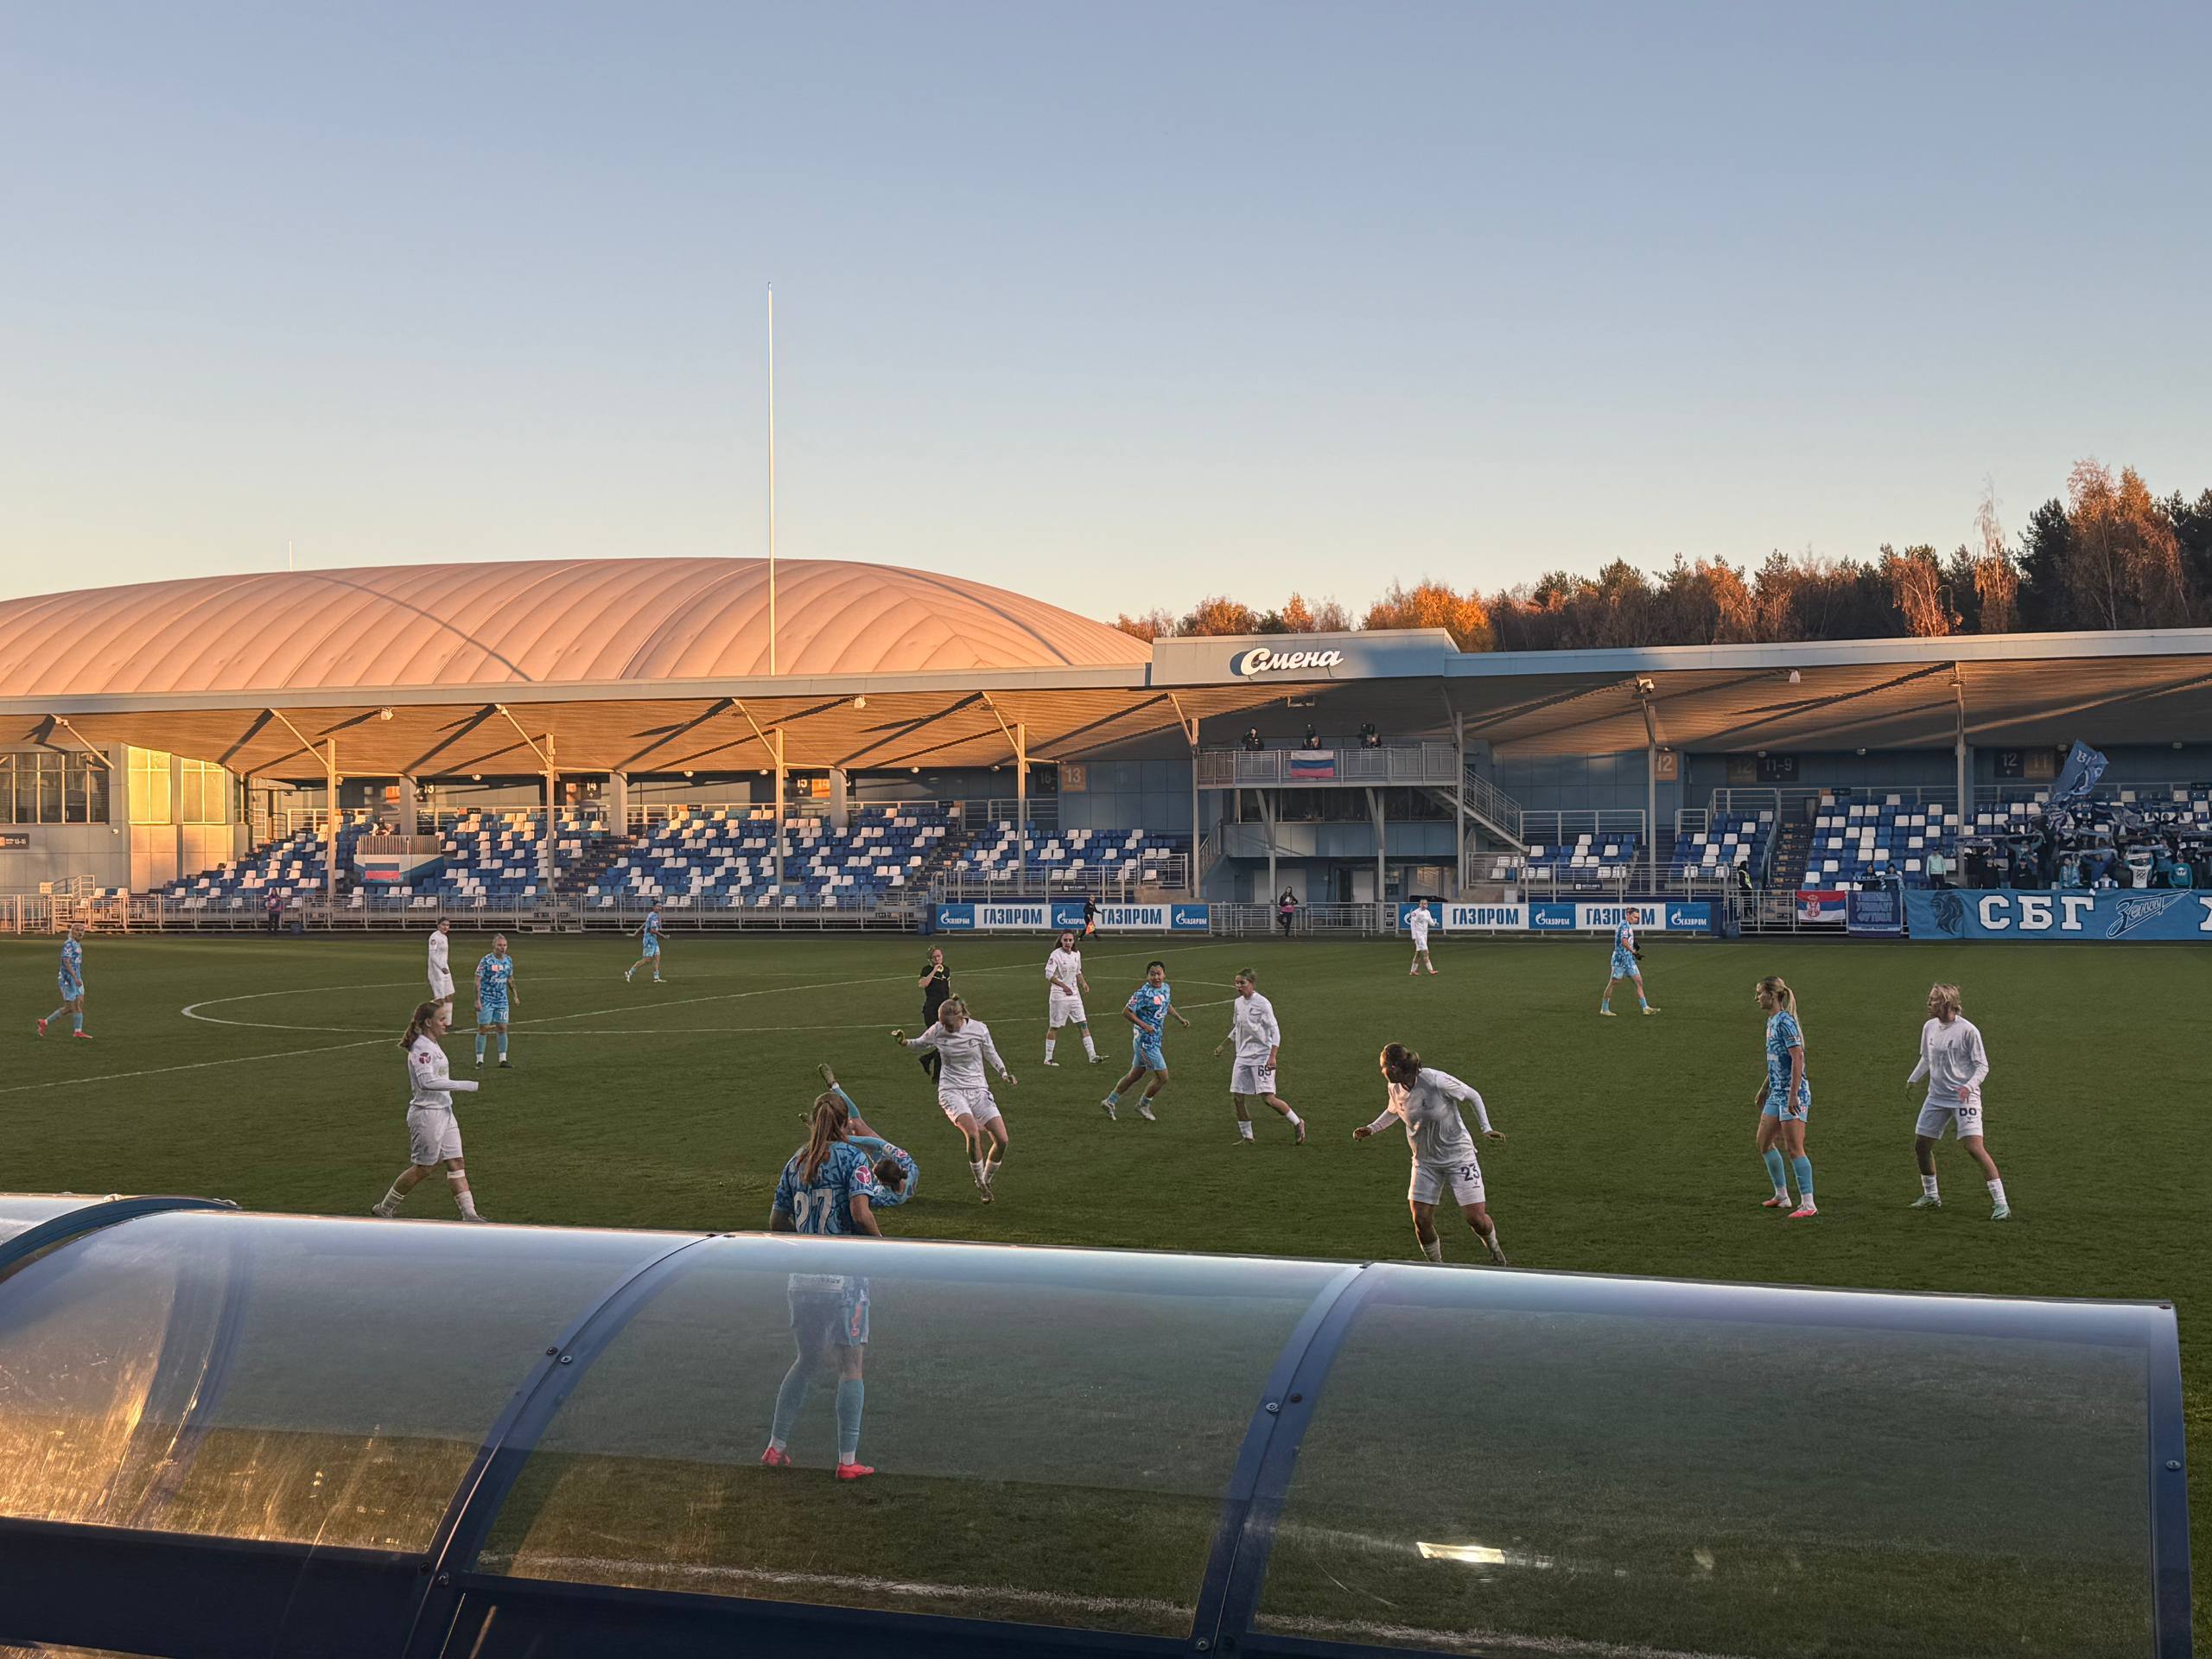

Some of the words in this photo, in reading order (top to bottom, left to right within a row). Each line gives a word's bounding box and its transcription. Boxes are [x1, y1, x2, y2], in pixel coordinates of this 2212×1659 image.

[1241, 648, 1344, 675] Смена
[1656, 755, 1673, 772] 12
[1765, 758, 1793, 772] 11-9
[2001, 753, 2018, 766] 12
[1065, 767, 1081, 783] 13
[983, 908, 1042, 925] ГАЗПРОМ
[1102, 908, 1161, 925] ГАЗПРОМ
[1452, 908, 1519, 925] ГАЗПРОМ
[1586, 908, 1656, 925] ГАЗПМ
[1978, 895, 2094, 931] СБГ
[1461, 1163, 1480, 1181] 23
[793, 1188, 833, 1234] 27
